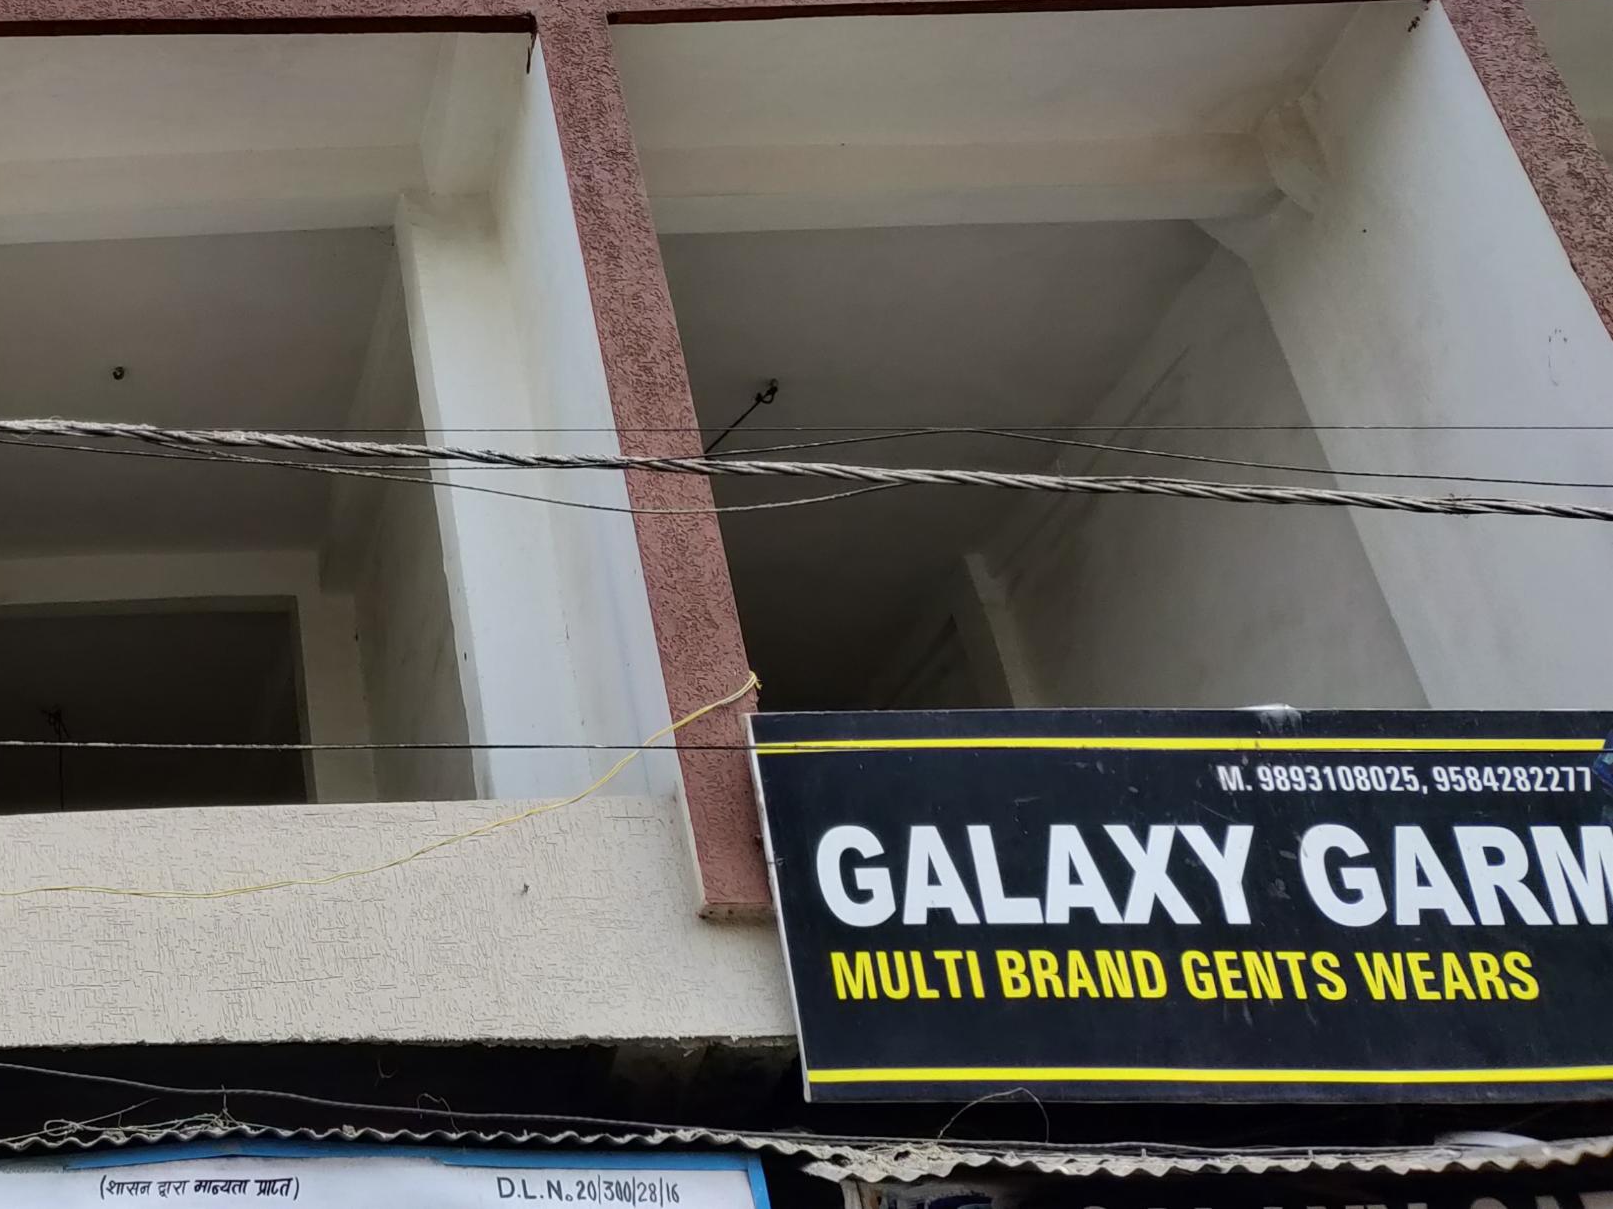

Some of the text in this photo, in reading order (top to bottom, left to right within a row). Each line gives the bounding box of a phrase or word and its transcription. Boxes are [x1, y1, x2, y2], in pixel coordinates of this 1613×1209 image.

[1217, 765, 1592, 795] M. 9893108025, 9584282277
[816, 823, 1613, 927] GALAXY GARM
[831, 949, 1540, 1001] MULTI BRAND GENTS WEARS
[157, 1179, 191, 1199] द्वारा
[194, 1178, 251, 1196] मान्यता
